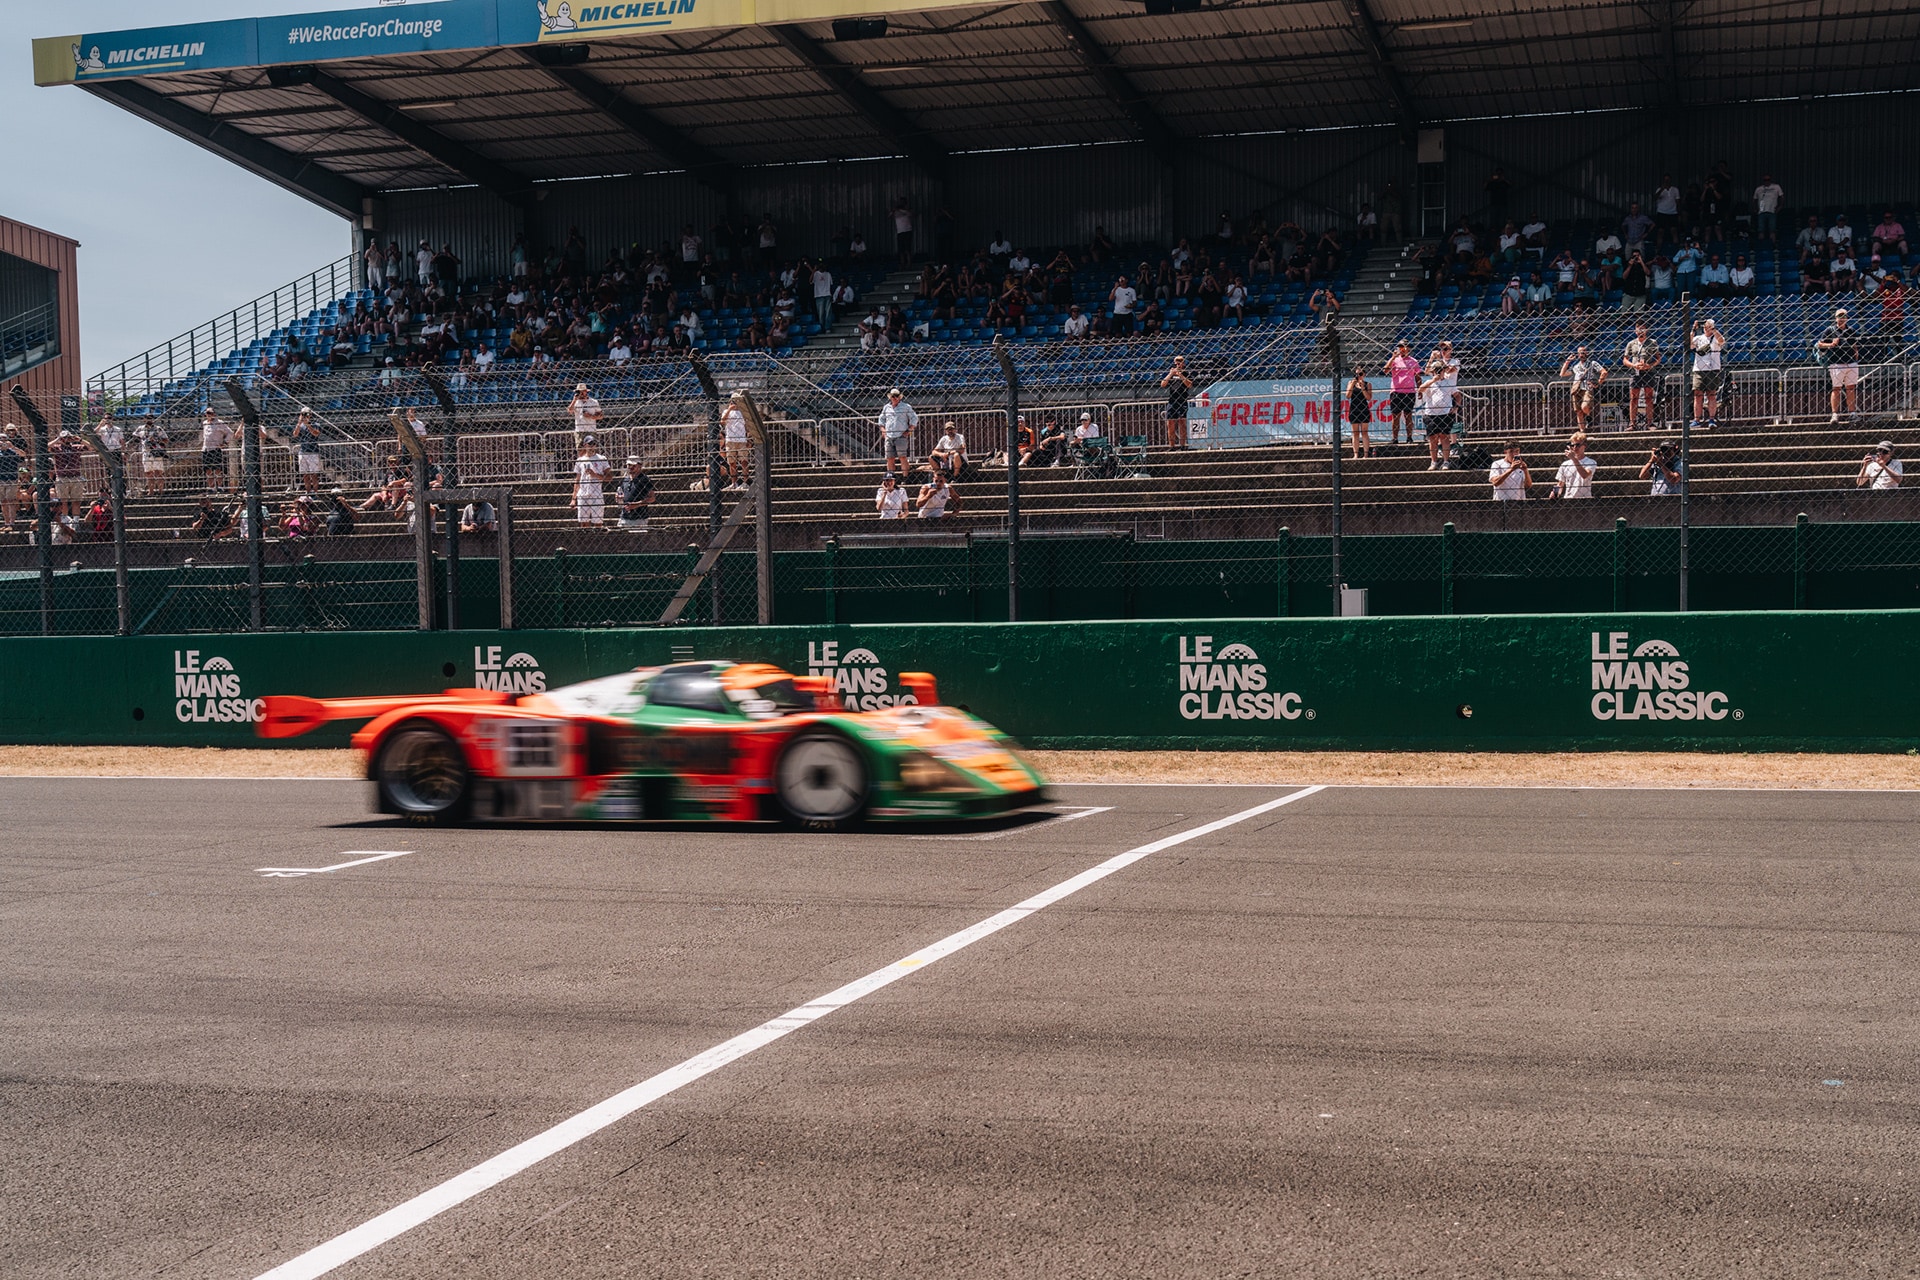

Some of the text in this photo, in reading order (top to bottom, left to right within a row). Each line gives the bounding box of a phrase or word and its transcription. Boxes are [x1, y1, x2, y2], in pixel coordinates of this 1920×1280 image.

[579, 0, 696, 22] MICHELIN
[288, 18, 443, 44] #WeRaceForChange
[107, 42, 205, 64] MICHELIN
[1212, 400, 1294, 426] FRED
[475, 646, 501, 670] LE
[808, 641, 838, 666] LE
[1179, 636, 1213, 662] LE
[1591, 632, 1629, 660] LE
[175, 650, 200, 673] LE
[175, 674, 240, 698] MANS
[475, 671, 546, 695] MANS
[1179, 663, 1267, 691] MANS
[1591, 661, 1690, 690] MANS
[176, 698, 267, 722] CLASSIC
[1179, 692, 1302, 720] CLASSIC
[1591, 691, 1729, 720] CLASSIC
